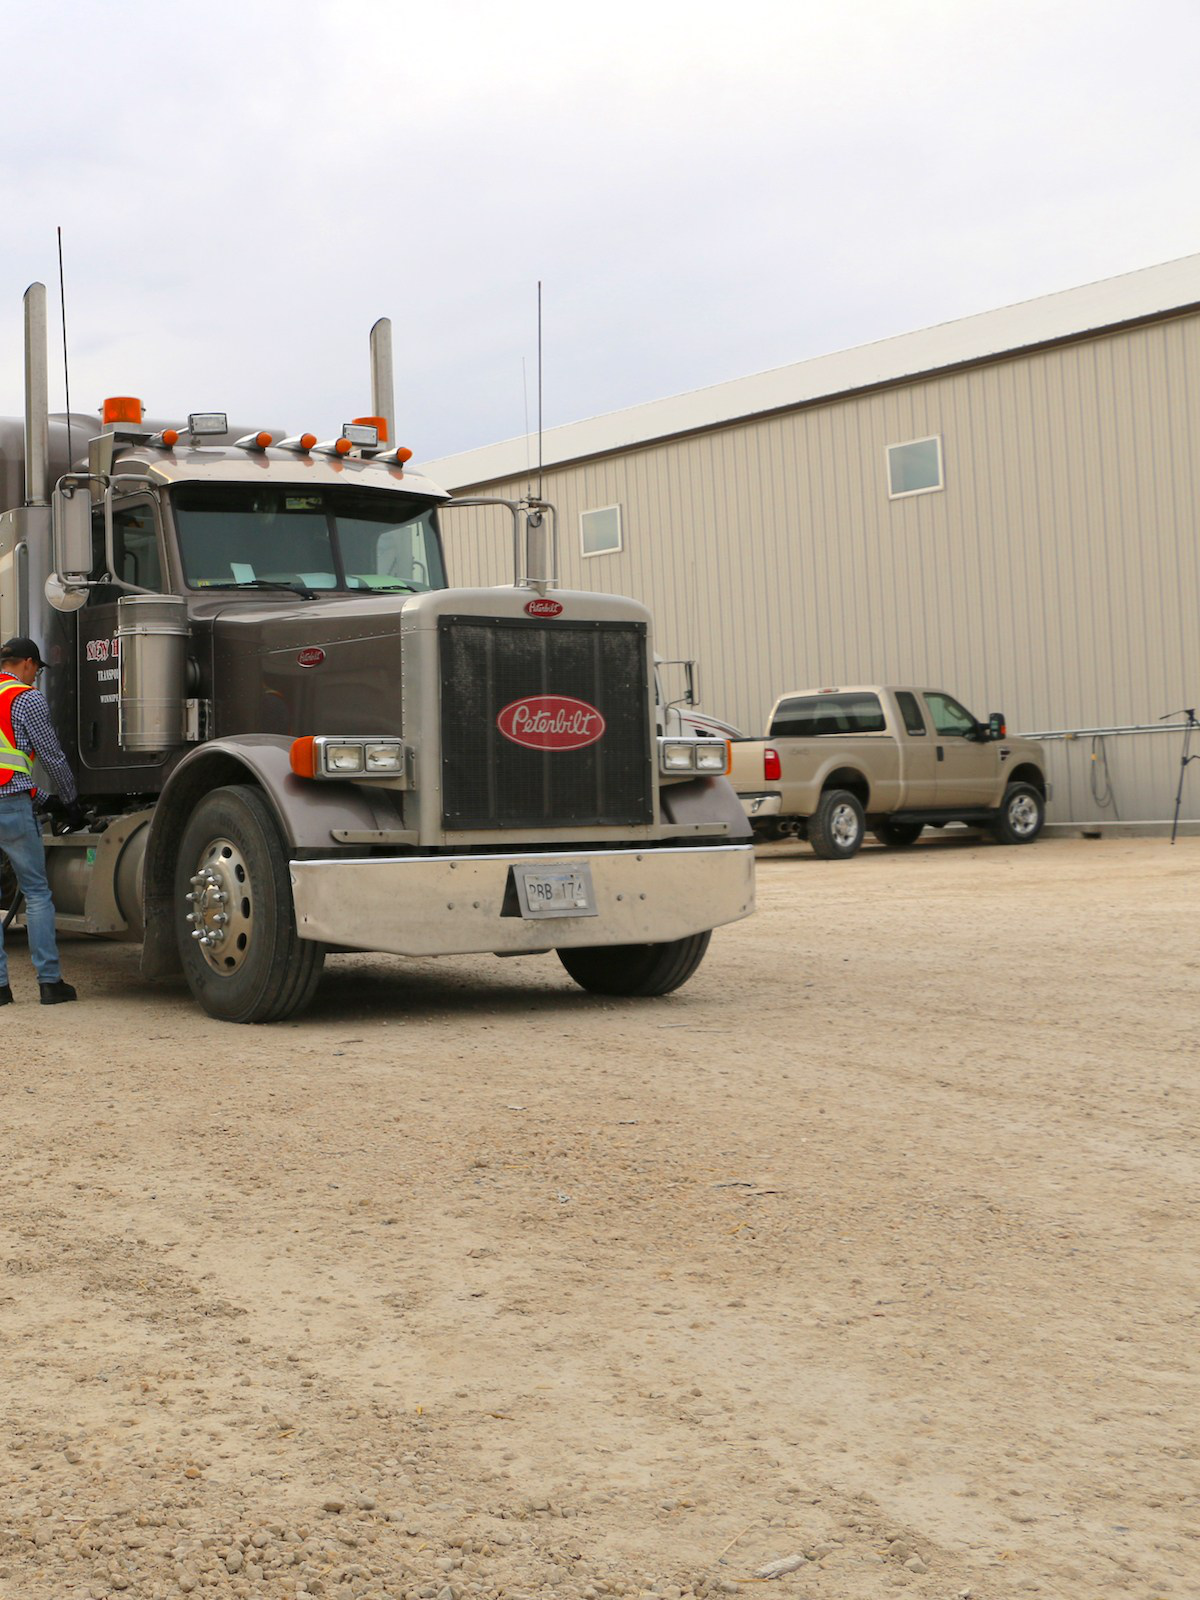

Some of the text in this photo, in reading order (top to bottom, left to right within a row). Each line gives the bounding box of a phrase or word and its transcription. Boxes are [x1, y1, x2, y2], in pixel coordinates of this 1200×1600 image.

[529, 602, 561, 613] Peterbilt
[86, 639, 110, 661] NEW
[511, 705, 597, 735] Peterbilt
